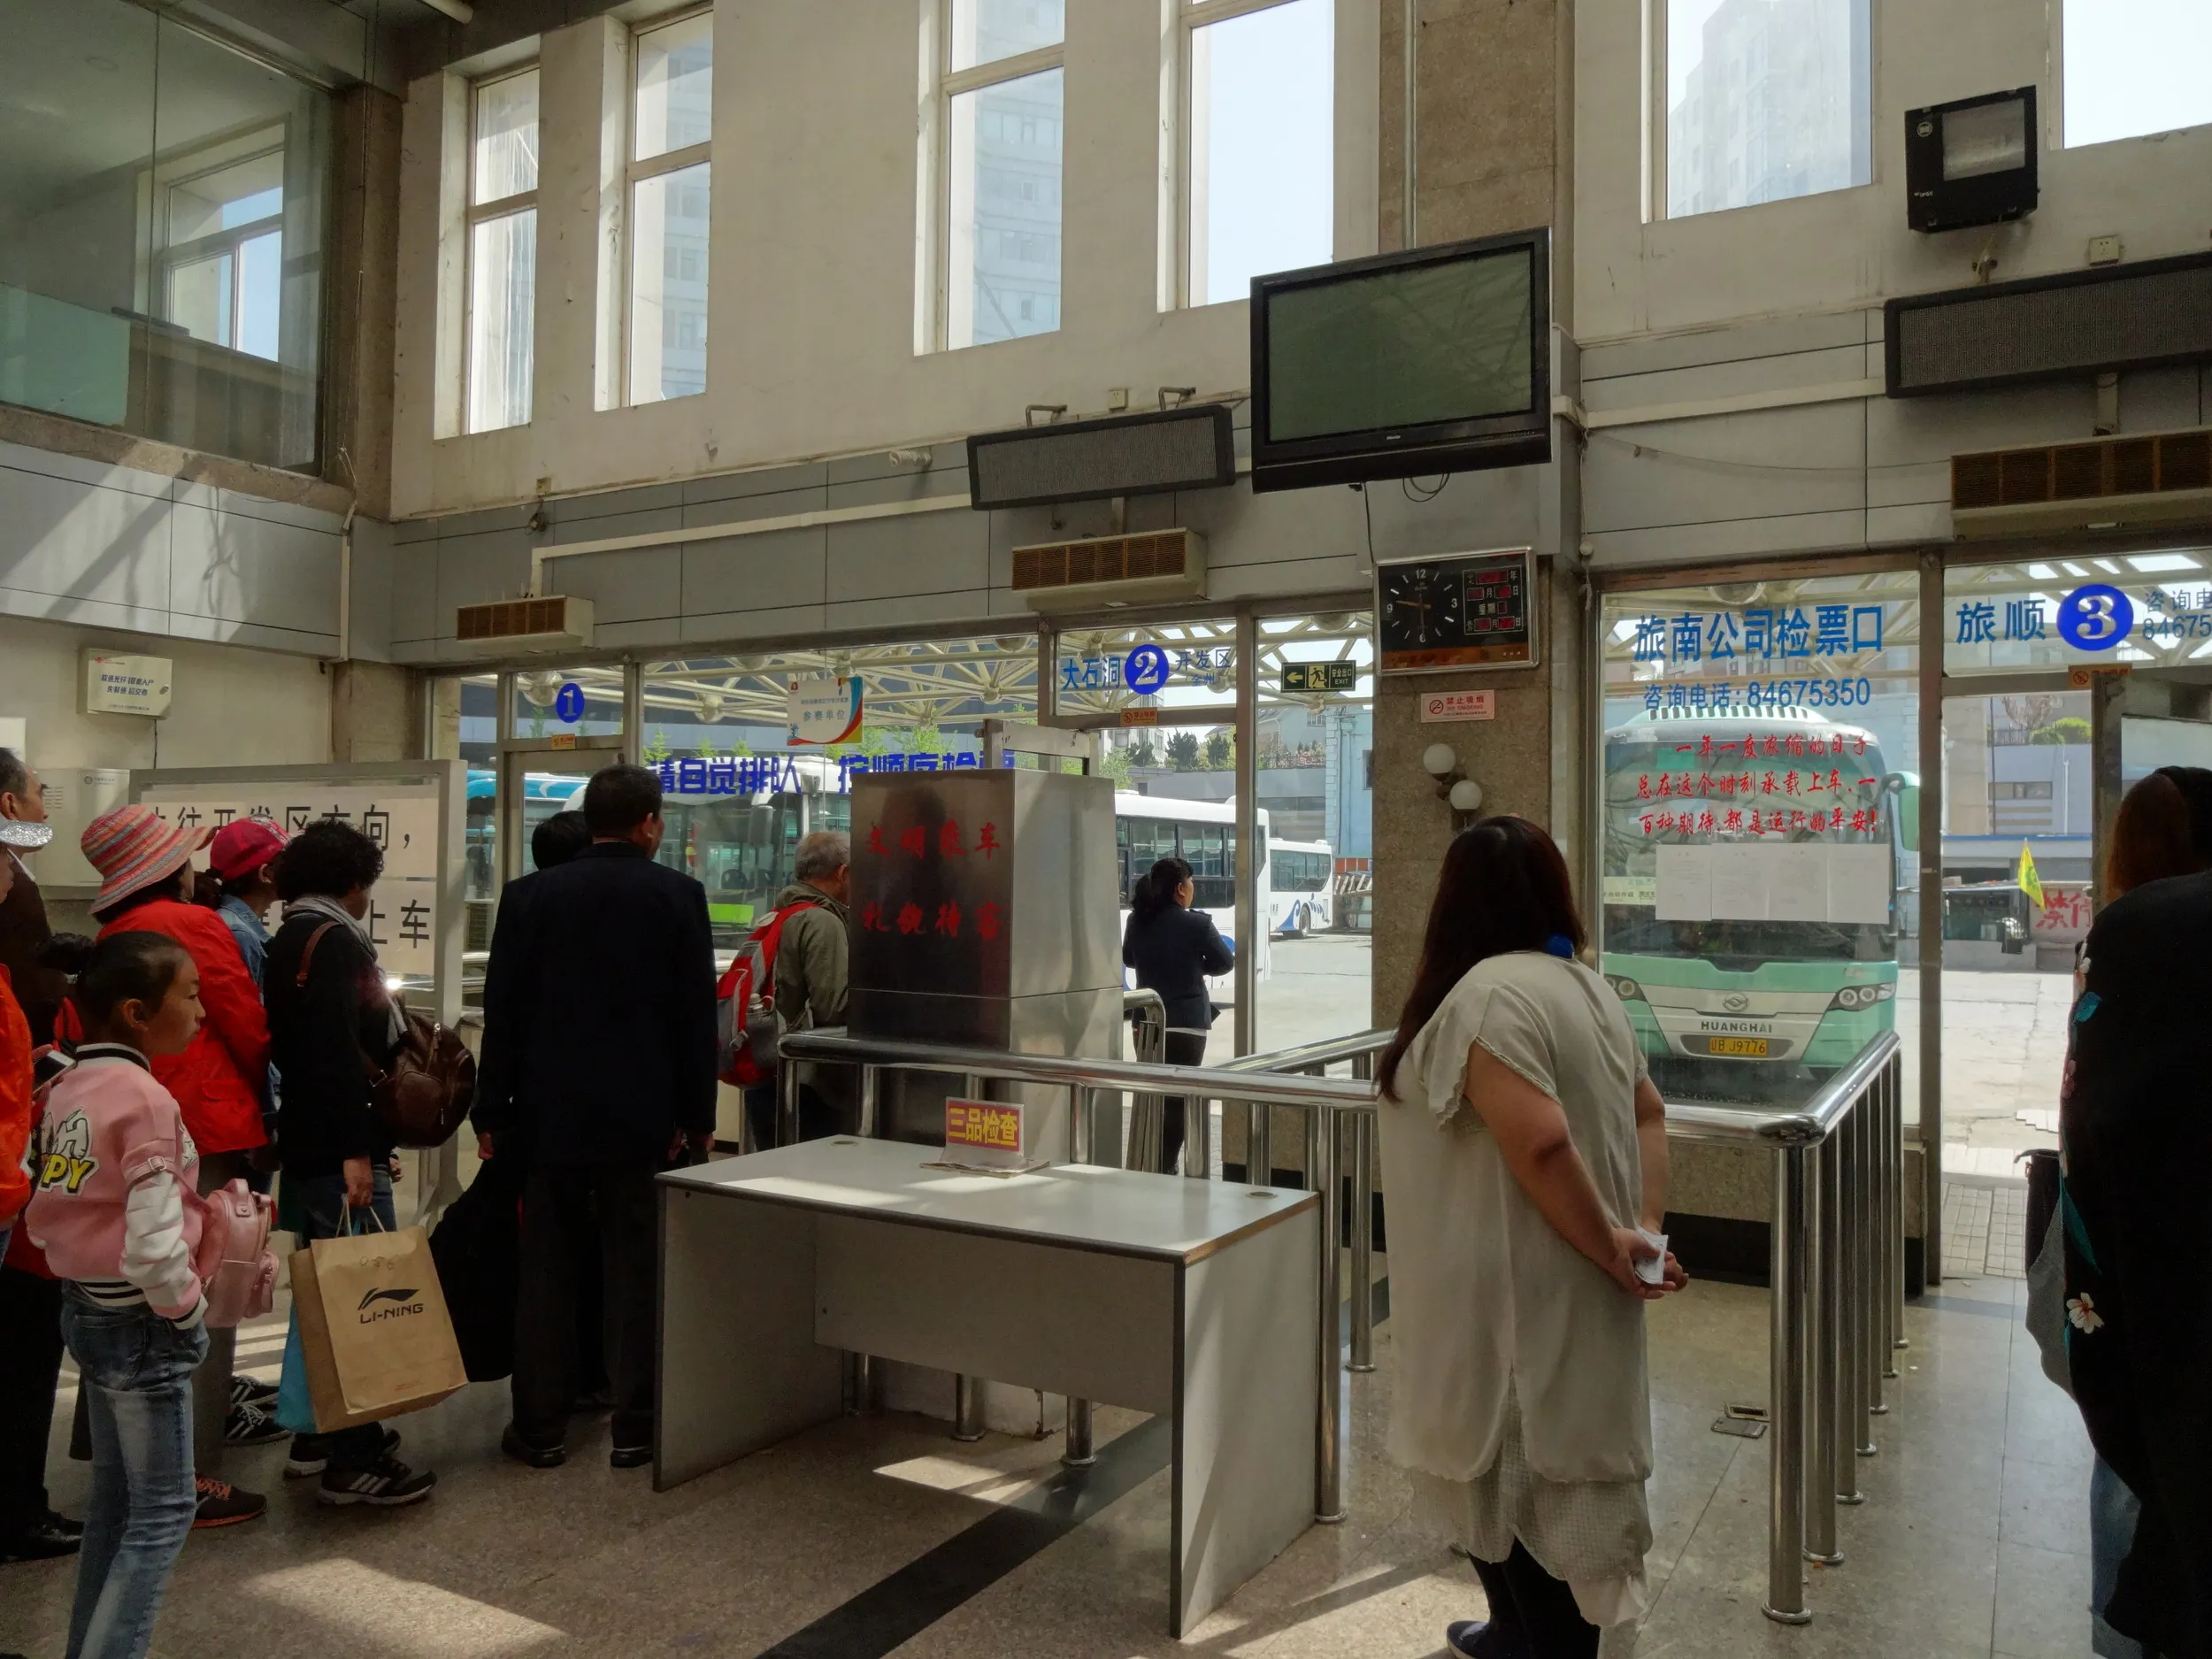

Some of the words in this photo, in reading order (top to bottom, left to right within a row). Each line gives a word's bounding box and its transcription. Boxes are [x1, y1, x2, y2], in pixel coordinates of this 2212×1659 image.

[1416, 569, 1426, 580] 12
[1386, 603, 1394, 614] 9
[1451, 598, 1458, 609] 3
[1955, 599, 2047, 644] 旅顺
[2076, 595, 2117, 640] 3
[1632, 605, 1883, 663] 旅南公司检票口
[1062, 657, 1121, 691] 大石洞
[1134, 651, 1159, 686] 2
[1175, 649, 1232, 672] 开发区
[1701, 1021, 1773, 1033] HUANGHAI
[1729, 1039, 1766, 1054] J9776
[949, 1108, 1018, 1147] 三品检查
[360, 1303, 424, 1325] LI-NING
